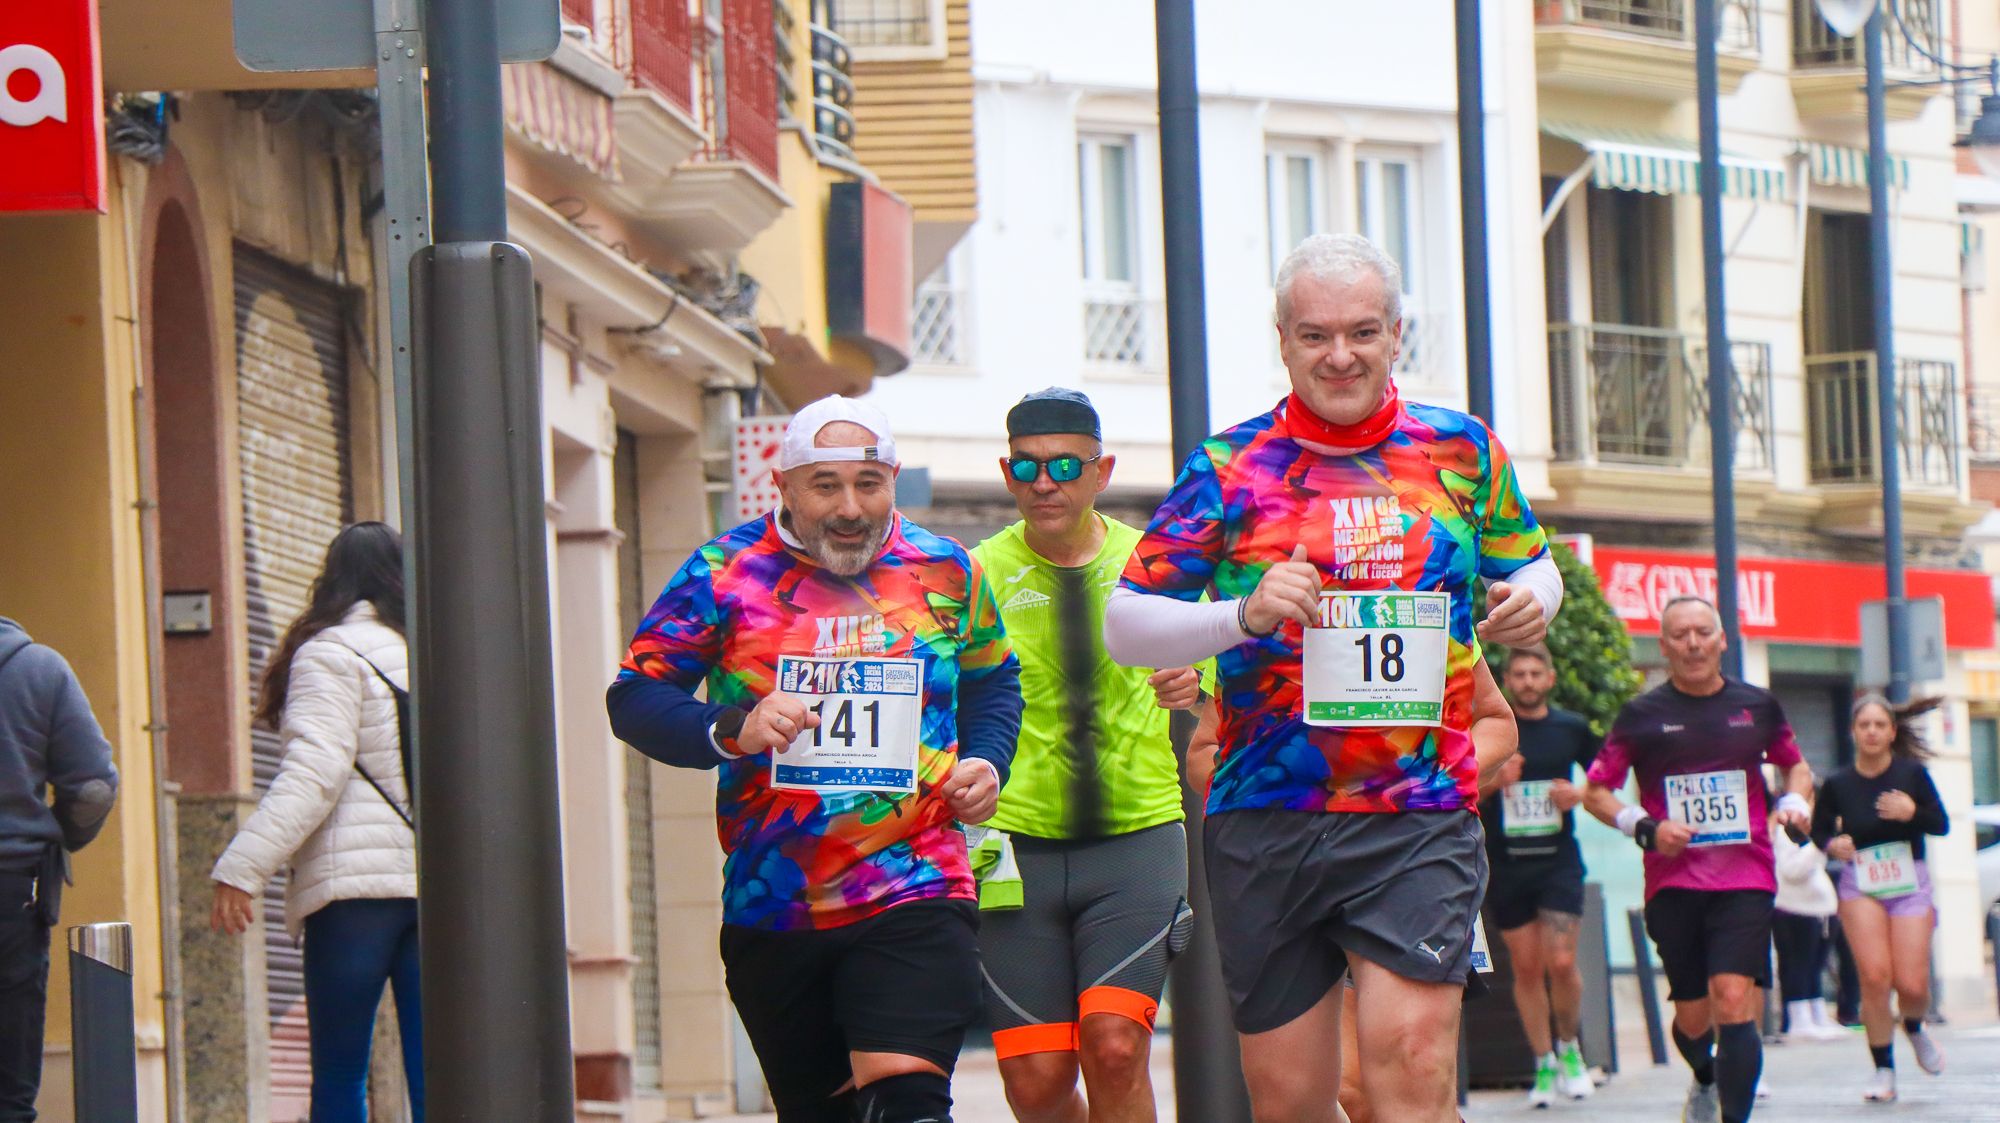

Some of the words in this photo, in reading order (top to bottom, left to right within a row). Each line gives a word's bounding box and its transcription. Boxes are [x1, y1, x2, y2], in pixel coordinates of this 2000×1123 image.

[1329, 497, 1377, 528] XII
[1375, 496, 1401, 516] 08
[1333, 527, 1380, 547] MEDIA
[1334, 540, 1404, 565] MARATÓN
[1342, 563, 1369, 580] 10K
[1371, 562, 1393, 571] Ciudad
[1371, 570, 1403, 579] LUCENA
[1645, 563, 1776, 626] GENEALI
[860, 613, 886, 634] 08
[1318, 597, 1363, 628] 10K
[815, 615, 859, 649] XII
[1355, 633, 1405, 682] 18
[799, 661, 840, 693] 21K
[864, 681, 883, 691] 2026
[810, 699, 880, 748] 141
[1513, 797, 1553, 818] 1320
[1680, 795, 1738, 825] 1355
[1868, 859, 1902, 882] 835
